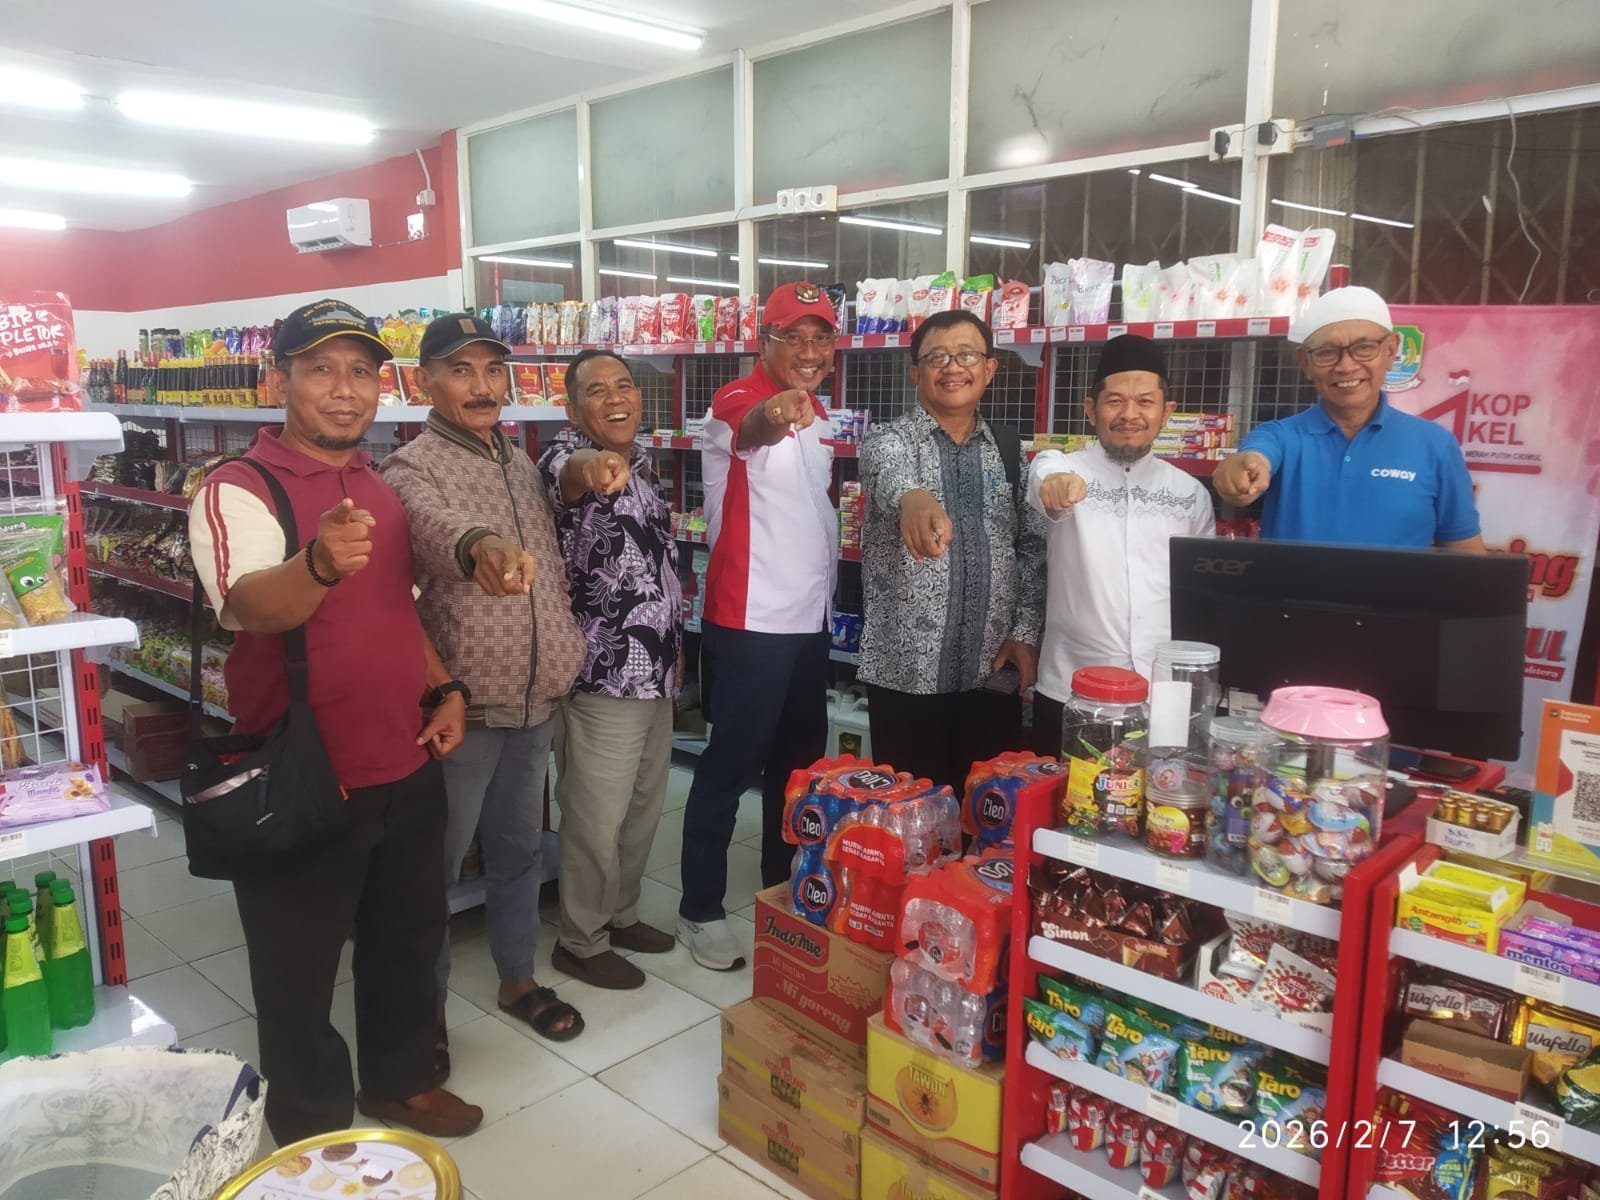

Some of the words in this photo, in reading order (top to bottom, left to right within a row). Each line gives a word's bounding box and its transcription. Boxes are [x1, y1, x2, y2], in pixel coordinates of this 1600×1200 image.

[1470, 393, 1532, 417] KOP
[1467, 421, 1524, 446] KEL
[1370, 468, 1417, 482] coway
[1193, 556, 1256, 575] acer
[854, 769, 891, 789] Cleo
[983, 798, 1005, 820] Cleo
[800, 816, 822, 837] Cleo
[806, 882, 827, 904] Cleo
[1410, 905, 1463, 925] Antangin
[1040, 920, 1090, 942] Simon
[1506, 949, 1571, 975] mentos
[1046, 988, 1081, 1018] Taro
[1408, 990, 1463, 1012] Wafello
[1026, 1012, 1056, 1038] Taro
[1106, 1013, 1144, 1044] Taro
[1186, 1040, 1232, 1063] Taro
[1526, 1031, 1588, 1055] Wafello
[1258, 1071, 1302, 1099] Taro
